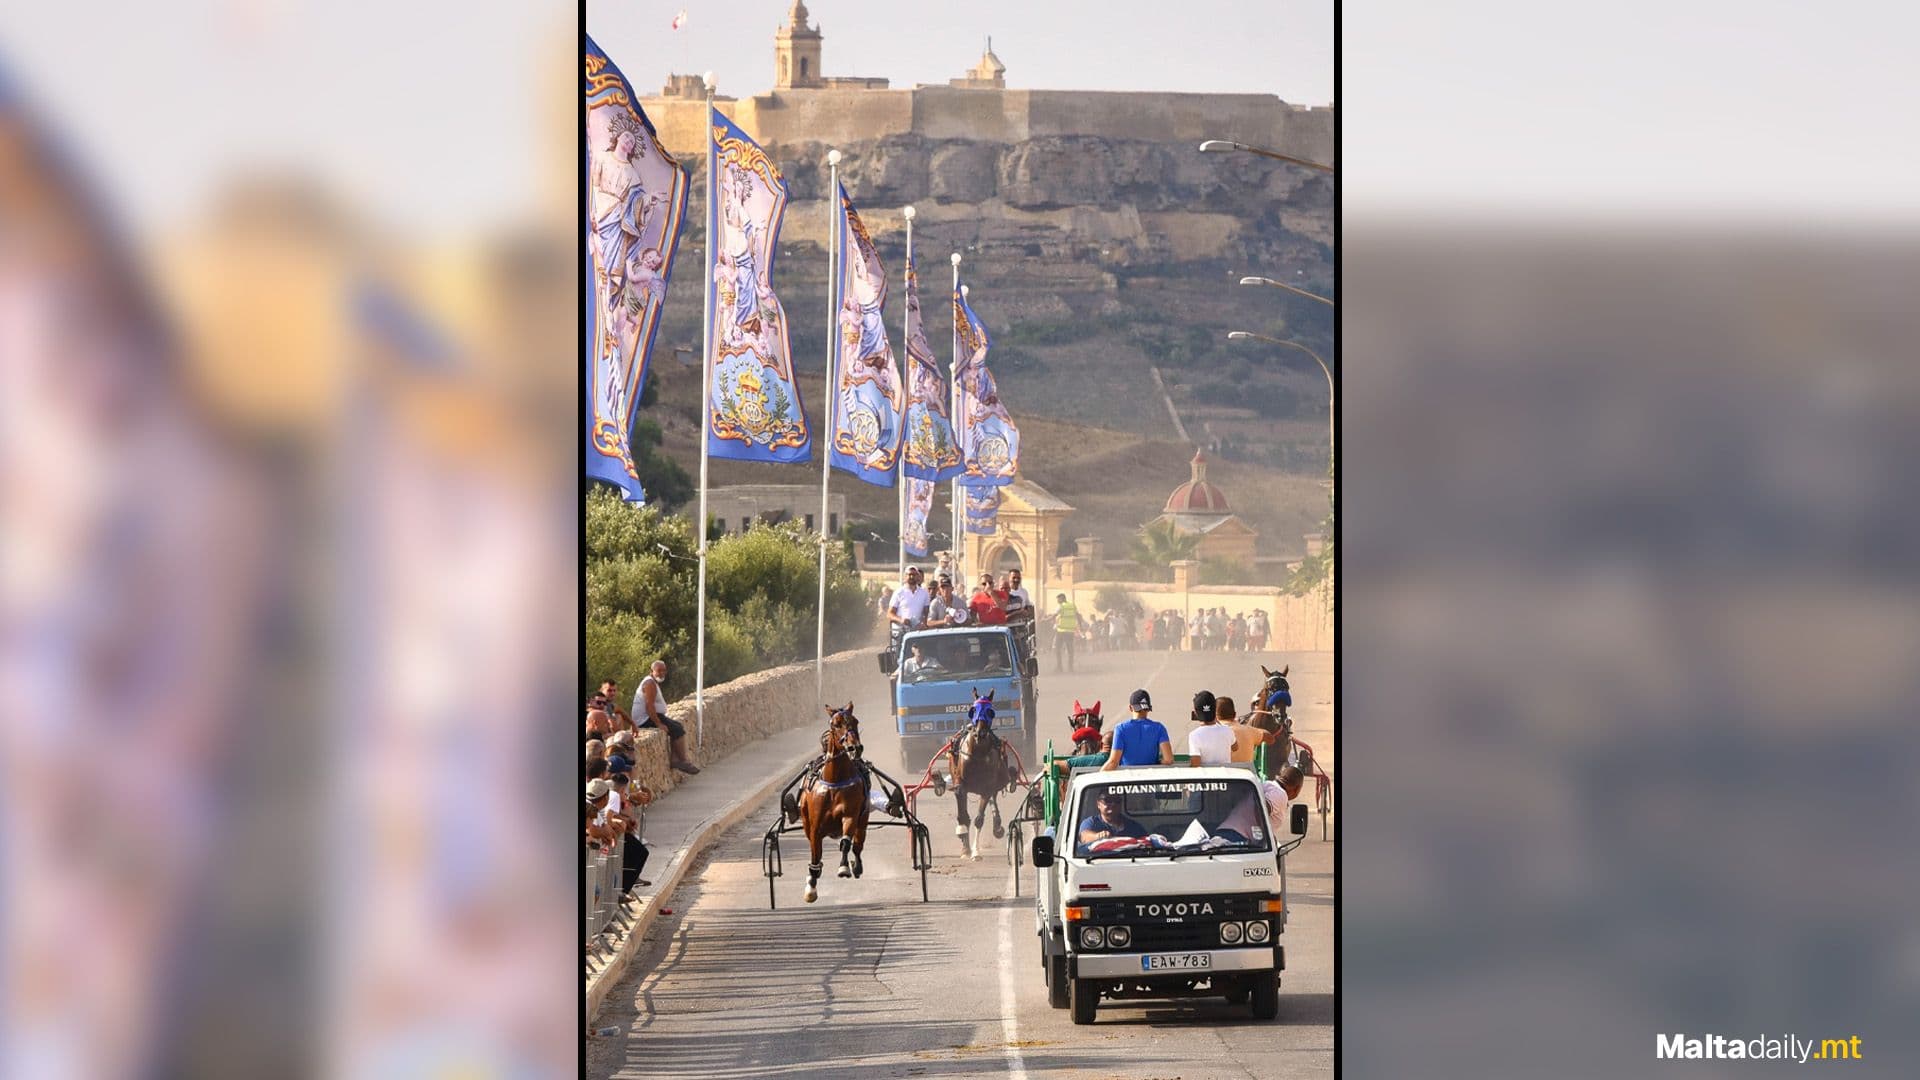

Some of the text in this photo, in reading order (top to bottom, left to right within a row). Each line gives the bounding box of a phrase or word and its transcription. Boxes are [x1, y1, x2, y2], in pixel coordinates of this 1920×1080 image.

[1243, 867, 1273, 877] DYNA
[1136, 902, 1214, 917] TOYOTA
[1151, 954, 1208, 968] EAW-783
